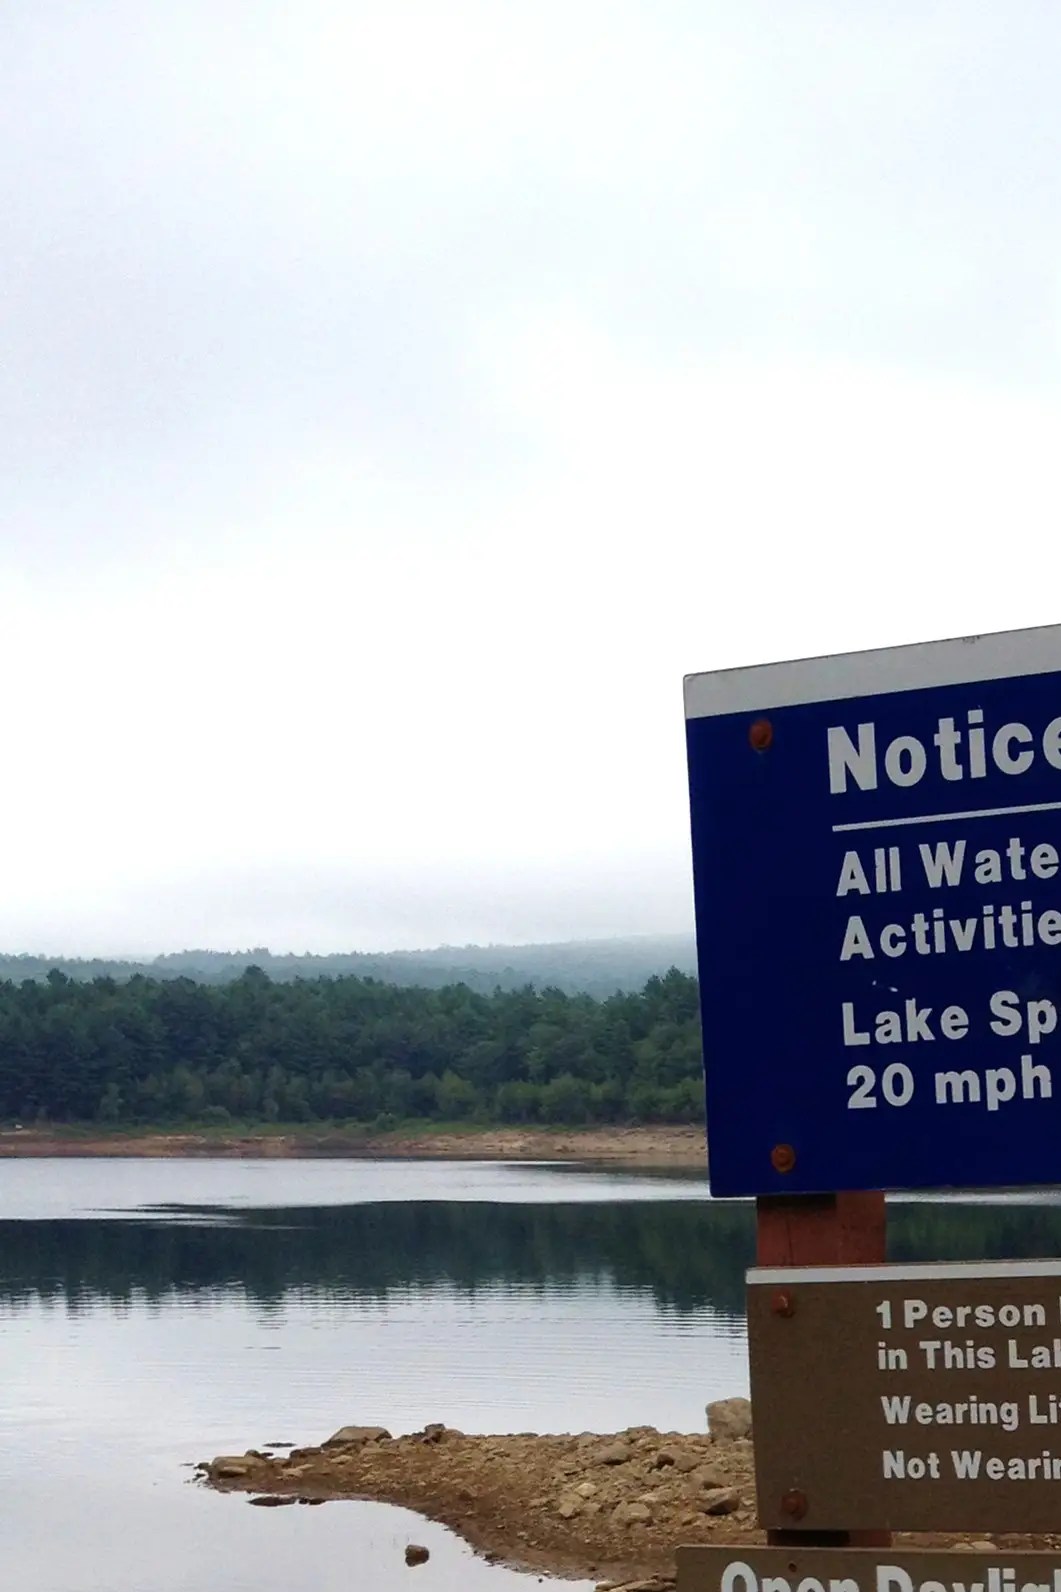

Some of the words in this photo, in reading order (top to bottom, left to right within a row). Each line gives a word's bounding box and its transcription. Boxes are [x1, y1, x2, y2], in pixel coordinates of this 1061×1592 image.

[835, 846, 902, 897] All
[841, 997, 969, 1046] Lake
[846, 1062, 915, 1109] 20
[934, 1054, 1052, 1112] mph
[875, 1300, 892, 1329] 1
[903, 1299, 1046, 1329] Person
[877, 1341, 908, 1370] in
[918, 1339, 996, 1370] This
[880, 1395, 1019, 1432] Wearing
[882, 1450, 941, 1479] Not
